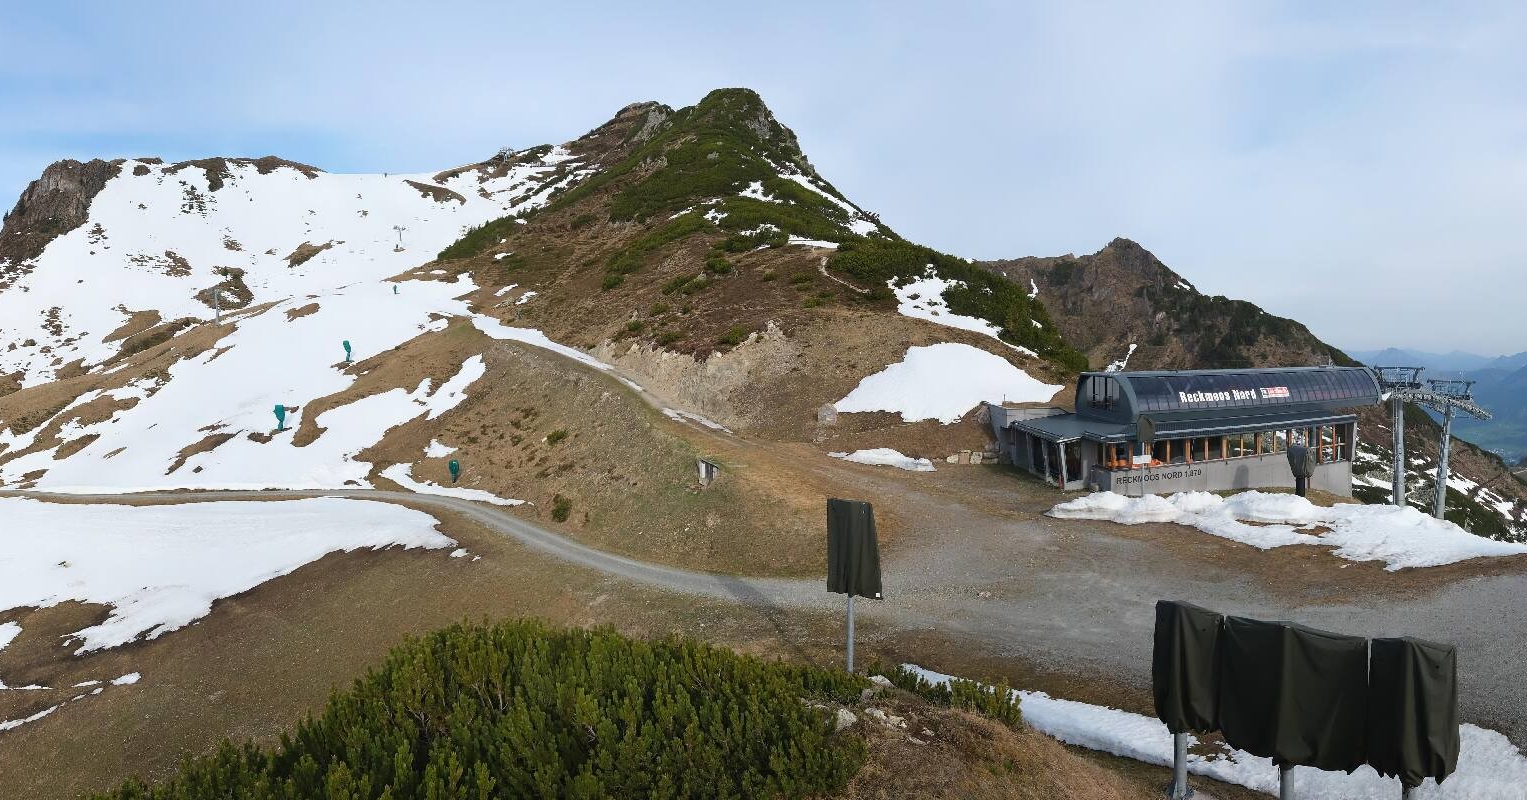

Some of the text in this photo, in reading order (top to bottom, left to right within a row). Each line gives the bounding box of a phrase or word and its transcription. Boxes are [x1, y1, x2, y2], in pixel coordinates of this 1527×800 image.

[1178, 391, 1231, 403] Reckmoos
[1232, 389, 1257, 400] Nord
[1116, 473, 1160, 485] RECKMOOS
[1162, 471, 1183, 480] NORD
